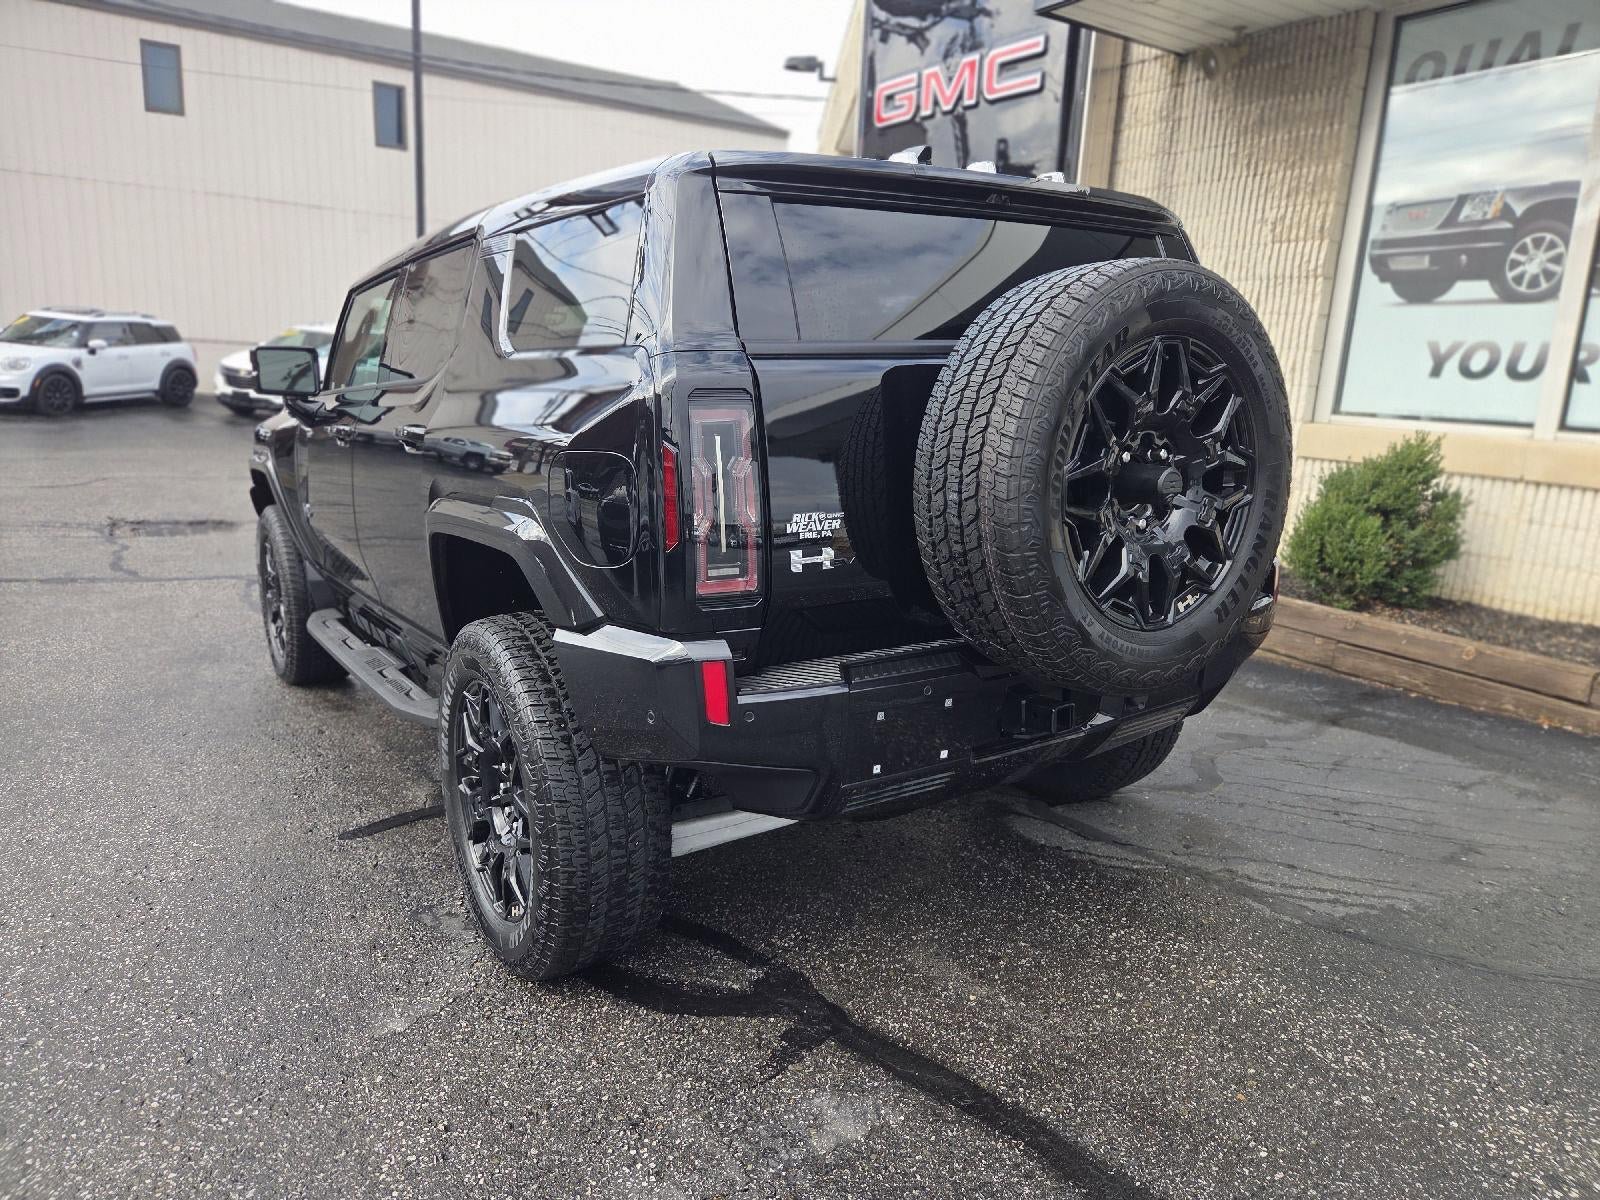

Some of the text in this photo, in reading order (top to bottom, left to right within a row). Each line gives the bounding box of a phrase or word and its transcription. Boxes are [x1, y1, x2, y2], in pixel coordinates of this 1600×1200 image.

[873, 34, 1047, 128] GMC
[1426, 340, 1600, 384] YOUR
[792, 512, 820, 523] RICK
[786, 519, 841, 534] WEAVER
[821, 530, 833, 538] PA
